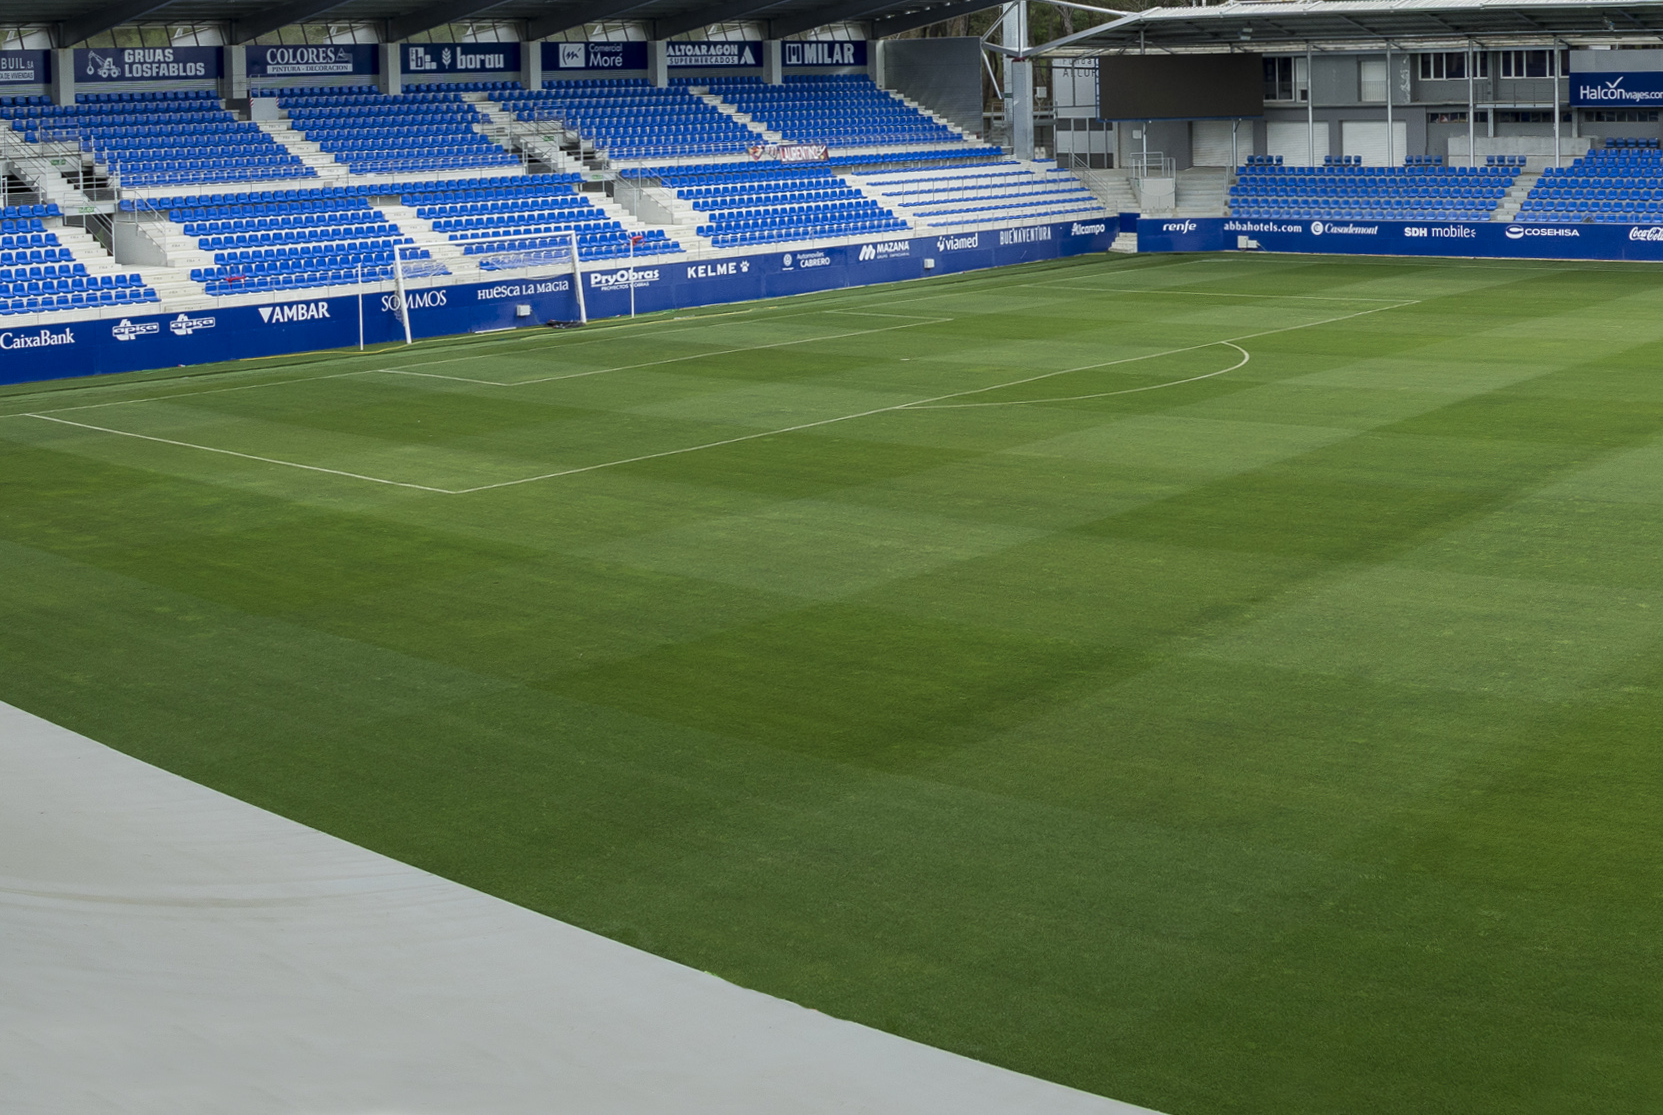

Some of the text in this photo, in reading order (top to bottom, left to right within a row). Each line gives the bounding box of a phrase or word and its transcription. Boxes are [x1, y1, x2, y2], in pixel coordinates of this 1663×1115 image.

[589, 44, 623, 52] Comercial
[667, 45, 738, 56] ALTOARAGON
[804, 43, 854, 64] MILAR
[125, 49, 174, 62] GRUAS
[267, 47, 335, 65] COLORES
[457, 47, 504, 69] borau
[589, 53, 623, 66] Moré
[125, 63, 205, 77] LOSFABLOS
[1072, 222, 1105, 236] Alcampo
[1163, 220, 1196, 234] renfe
[1224, 221, 1302, 232] abbahotels.com
[1324, 223, 1378, 235] Casademont
[1404, 225, 1470, 238] SDH mobile
[1525, 229, 1579, 237] COSEHISA
[945, 233, 978, 251] viamed
[1000, 226, 1051, 245] BUENAVENTURA
[877, 241, 910, 253] MAZANA
[800, 257, 830, 268] CABRERO
[688, 263, 737, 279] KELME
[272, 302, 330, 323] AMBAR
[0, 327, 75, 350] CaixaBank
